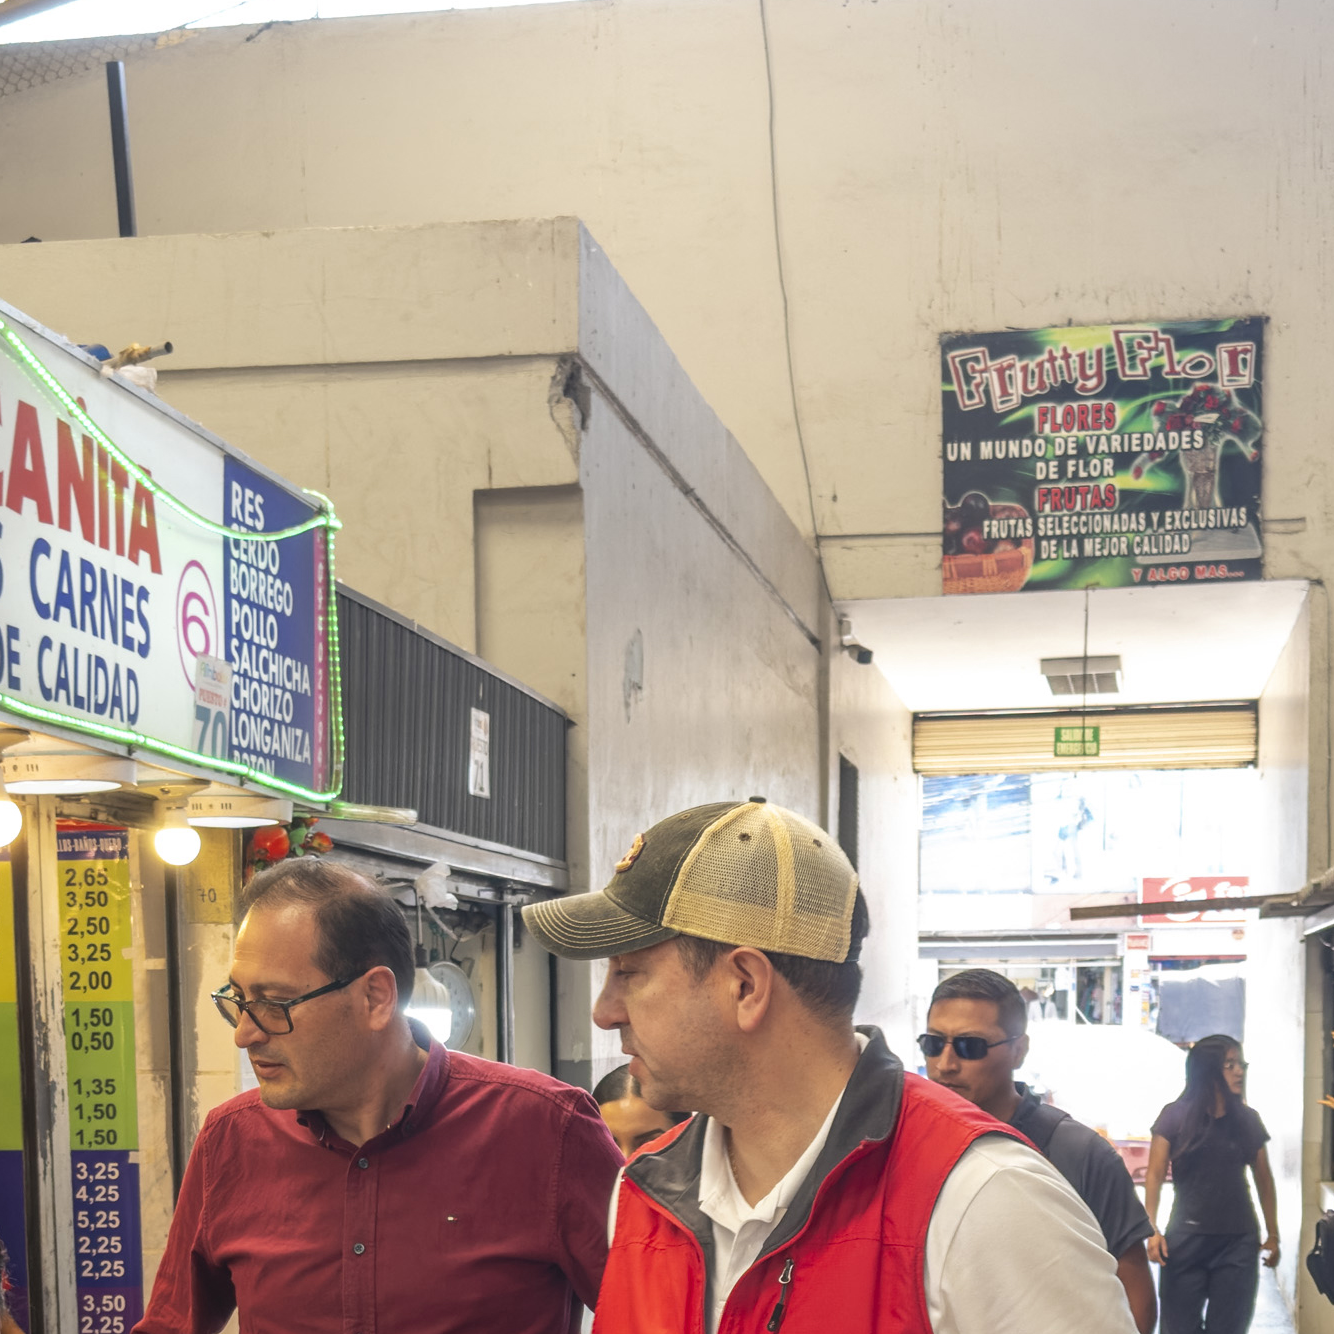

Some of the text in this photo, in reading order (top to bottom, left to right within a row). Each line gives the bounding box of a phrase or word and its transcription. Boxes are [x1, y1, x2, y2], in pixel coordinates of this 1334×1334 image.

[948, 328, 1255, 413] Frutty Flor
[1037, 402, 1116, 434] FLORES
[947, 430, 1204, 461] UN MUNDO DE VARIEDADES
[1036, 458, 1115, 480] DE FLOR
[231, 481, 264, 531] RES
[1037, 484, 1116, 512] FRUTAS
[983, 507, 1248, 540] FRUTAS SELECCIONADAS Y EXCLUSIVAS
[229, 522, 279, 575] CERDO
[1041, 534, 1191, 560] DE LA MEJOR CALIDAD
[1132, 568, 1142, 582] Y
[1147, 566, 1189, 582] ALGO
[30, 537, 150, 658] CARNES
[230, 558, 292, 617] BORREGO
[182, 591, 210, 658] 6
[231, 598, 278, 649] POLLO
[231, 638, 311, 697] SALCHICHA
[37, 635, 139, 726] CALIDAD
[231, 675, 293, 724] CHORIZO
[231, 710, 311, 765] LONGANIZA
[65, 868, 108, 889] 2,65
[66, 890, 108, 910] 3,50
[67, 916, 110, 938] 2,50
[68, 943, 111, 965] 3,25
[69, 971, 112, 993] 2,00
[71, 1008, 113, 1030] 1,50
[72, 1032, 114, 1053] 0,50
[73, 1079, 116, 1097] 1,35
[75, 1103, 116, 1123] 1,50
[76, 1130, 117, 1148] 1,50
[76, 1163, 119, 1182] 3,25
[76, 1185, 119, 1204] 4,25
[77, 1211, 120, 1231] 5,25
[79, 1236, 122, 1256] 2,25
[81, 1261, 125, 1280] 2,25
[83, 1295, 125, 1314] 3,50
